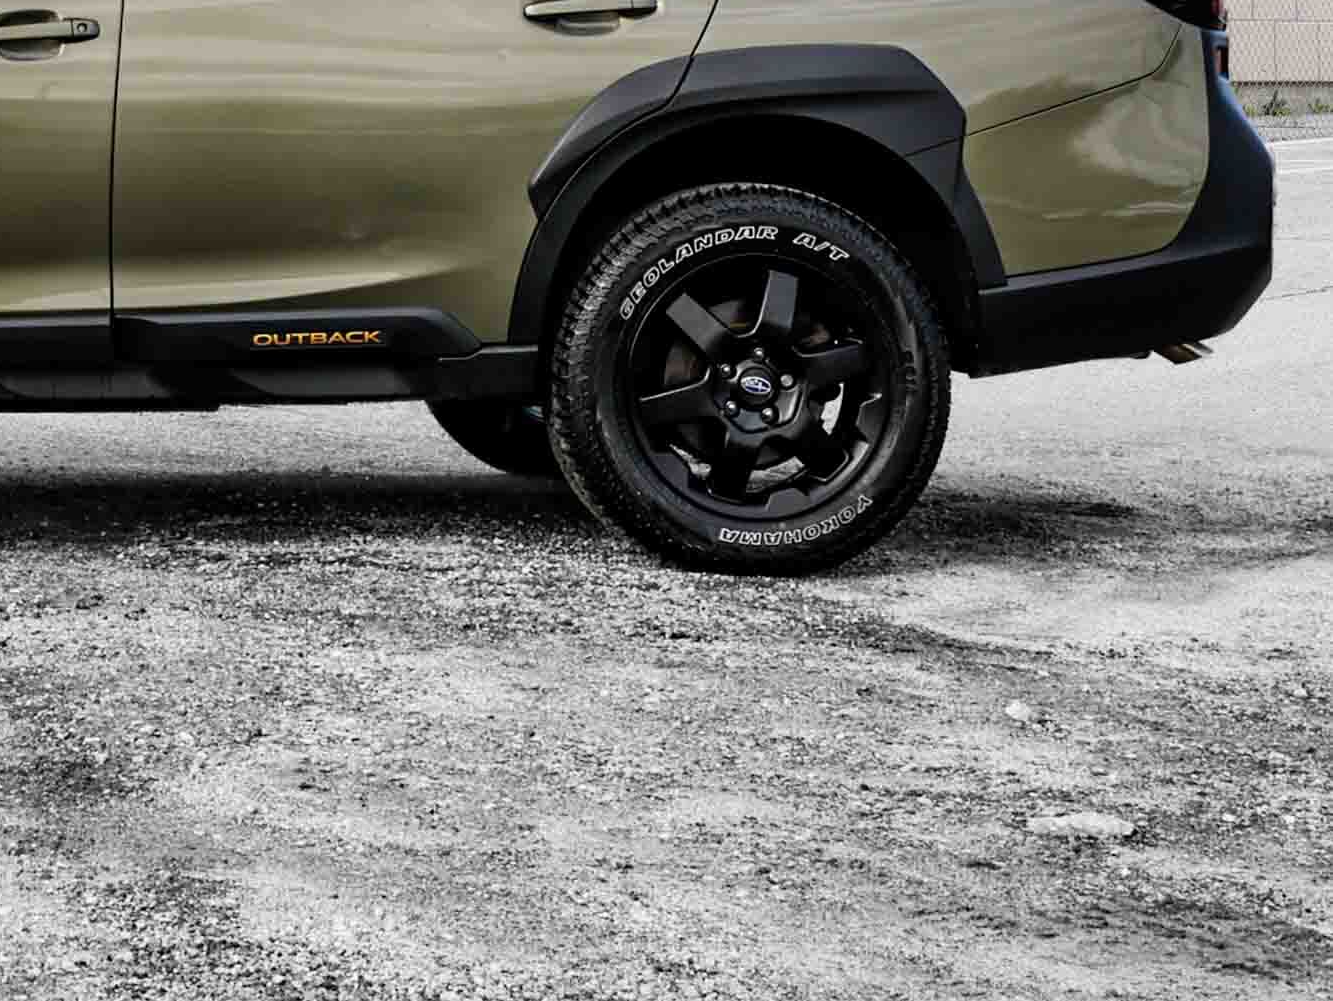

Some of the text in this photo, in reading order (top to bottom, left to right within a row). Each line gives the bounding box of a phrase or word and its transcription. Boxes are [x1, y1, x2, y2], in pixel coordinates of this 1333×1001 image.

[619, 225, 850, 320] GEOLANDAR A/T
[253, 331, 381, 346] OUTBACK
[718, 494, 874, 546] YOKOHAMA
